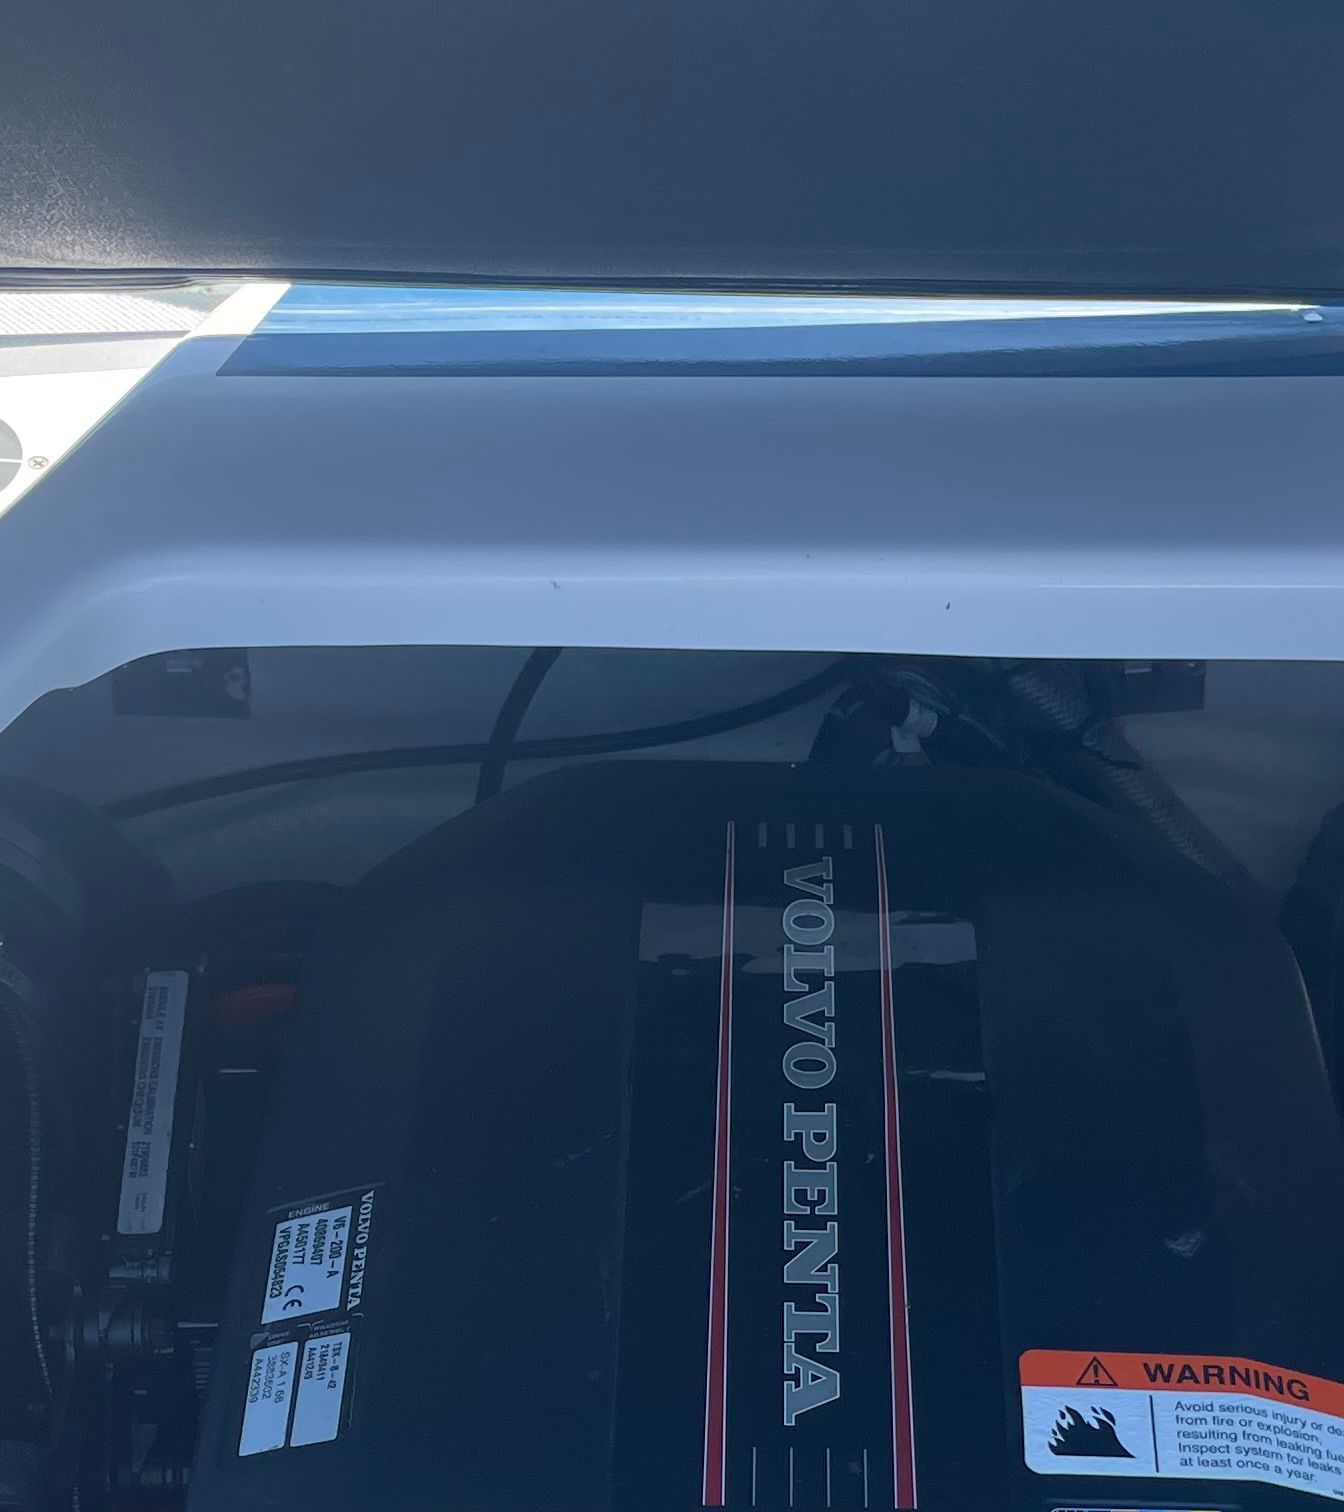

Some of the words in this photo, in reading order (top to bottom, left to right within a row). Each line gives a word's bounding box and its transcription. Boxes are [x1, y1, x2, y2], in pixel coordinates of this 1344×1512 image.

[782, 856, 838, 1089] VOLVO
[355, 1190, 374, 1244] VOLVO
[269, 1227, 292, 1299] VPGAS054823
[292, 1223, 313, 1265] A450177
[782, 1103, 841, 1426] PENTA
[346, 1247, 366, 1311] PENTA
[1143, 1361, 1310, 1402] WARNING
[1175, 1401, 1214, 1412] Avoid
[1218, 1402, 1268, 1418] serious
[1272, 1408, 1307, 1429] injury
[1310, 1419, 1323, 1431] or
[1176, 1414, 1208, 1425] from
[1212, 1416, 1235, 1428] fire
[1240, 1418, 1253, 1428] or
[1257, 1421, 1324, 1445] explosion,
[1177, 1429, 1239, 1443] resulting
[1242, 1432, 1272, 1447] from
[1276, 1437, 1323, 1459] leaking
[1178, 1442, 1231, 1456] Inspect
[1235, 1446, 1284, 1462] system
[1287, 1452, 1304, 1465] for
[1308, 1458, 1342, 1475] leaks
[1179, 1458, 1193, 1467] at
[1197, 1456, 1233, 1468] least
[1237, 1458, 1271, 1472] once
[1275, 1464, 1283, 1474] a
[1287, 1468, 1318, 1482] year.
